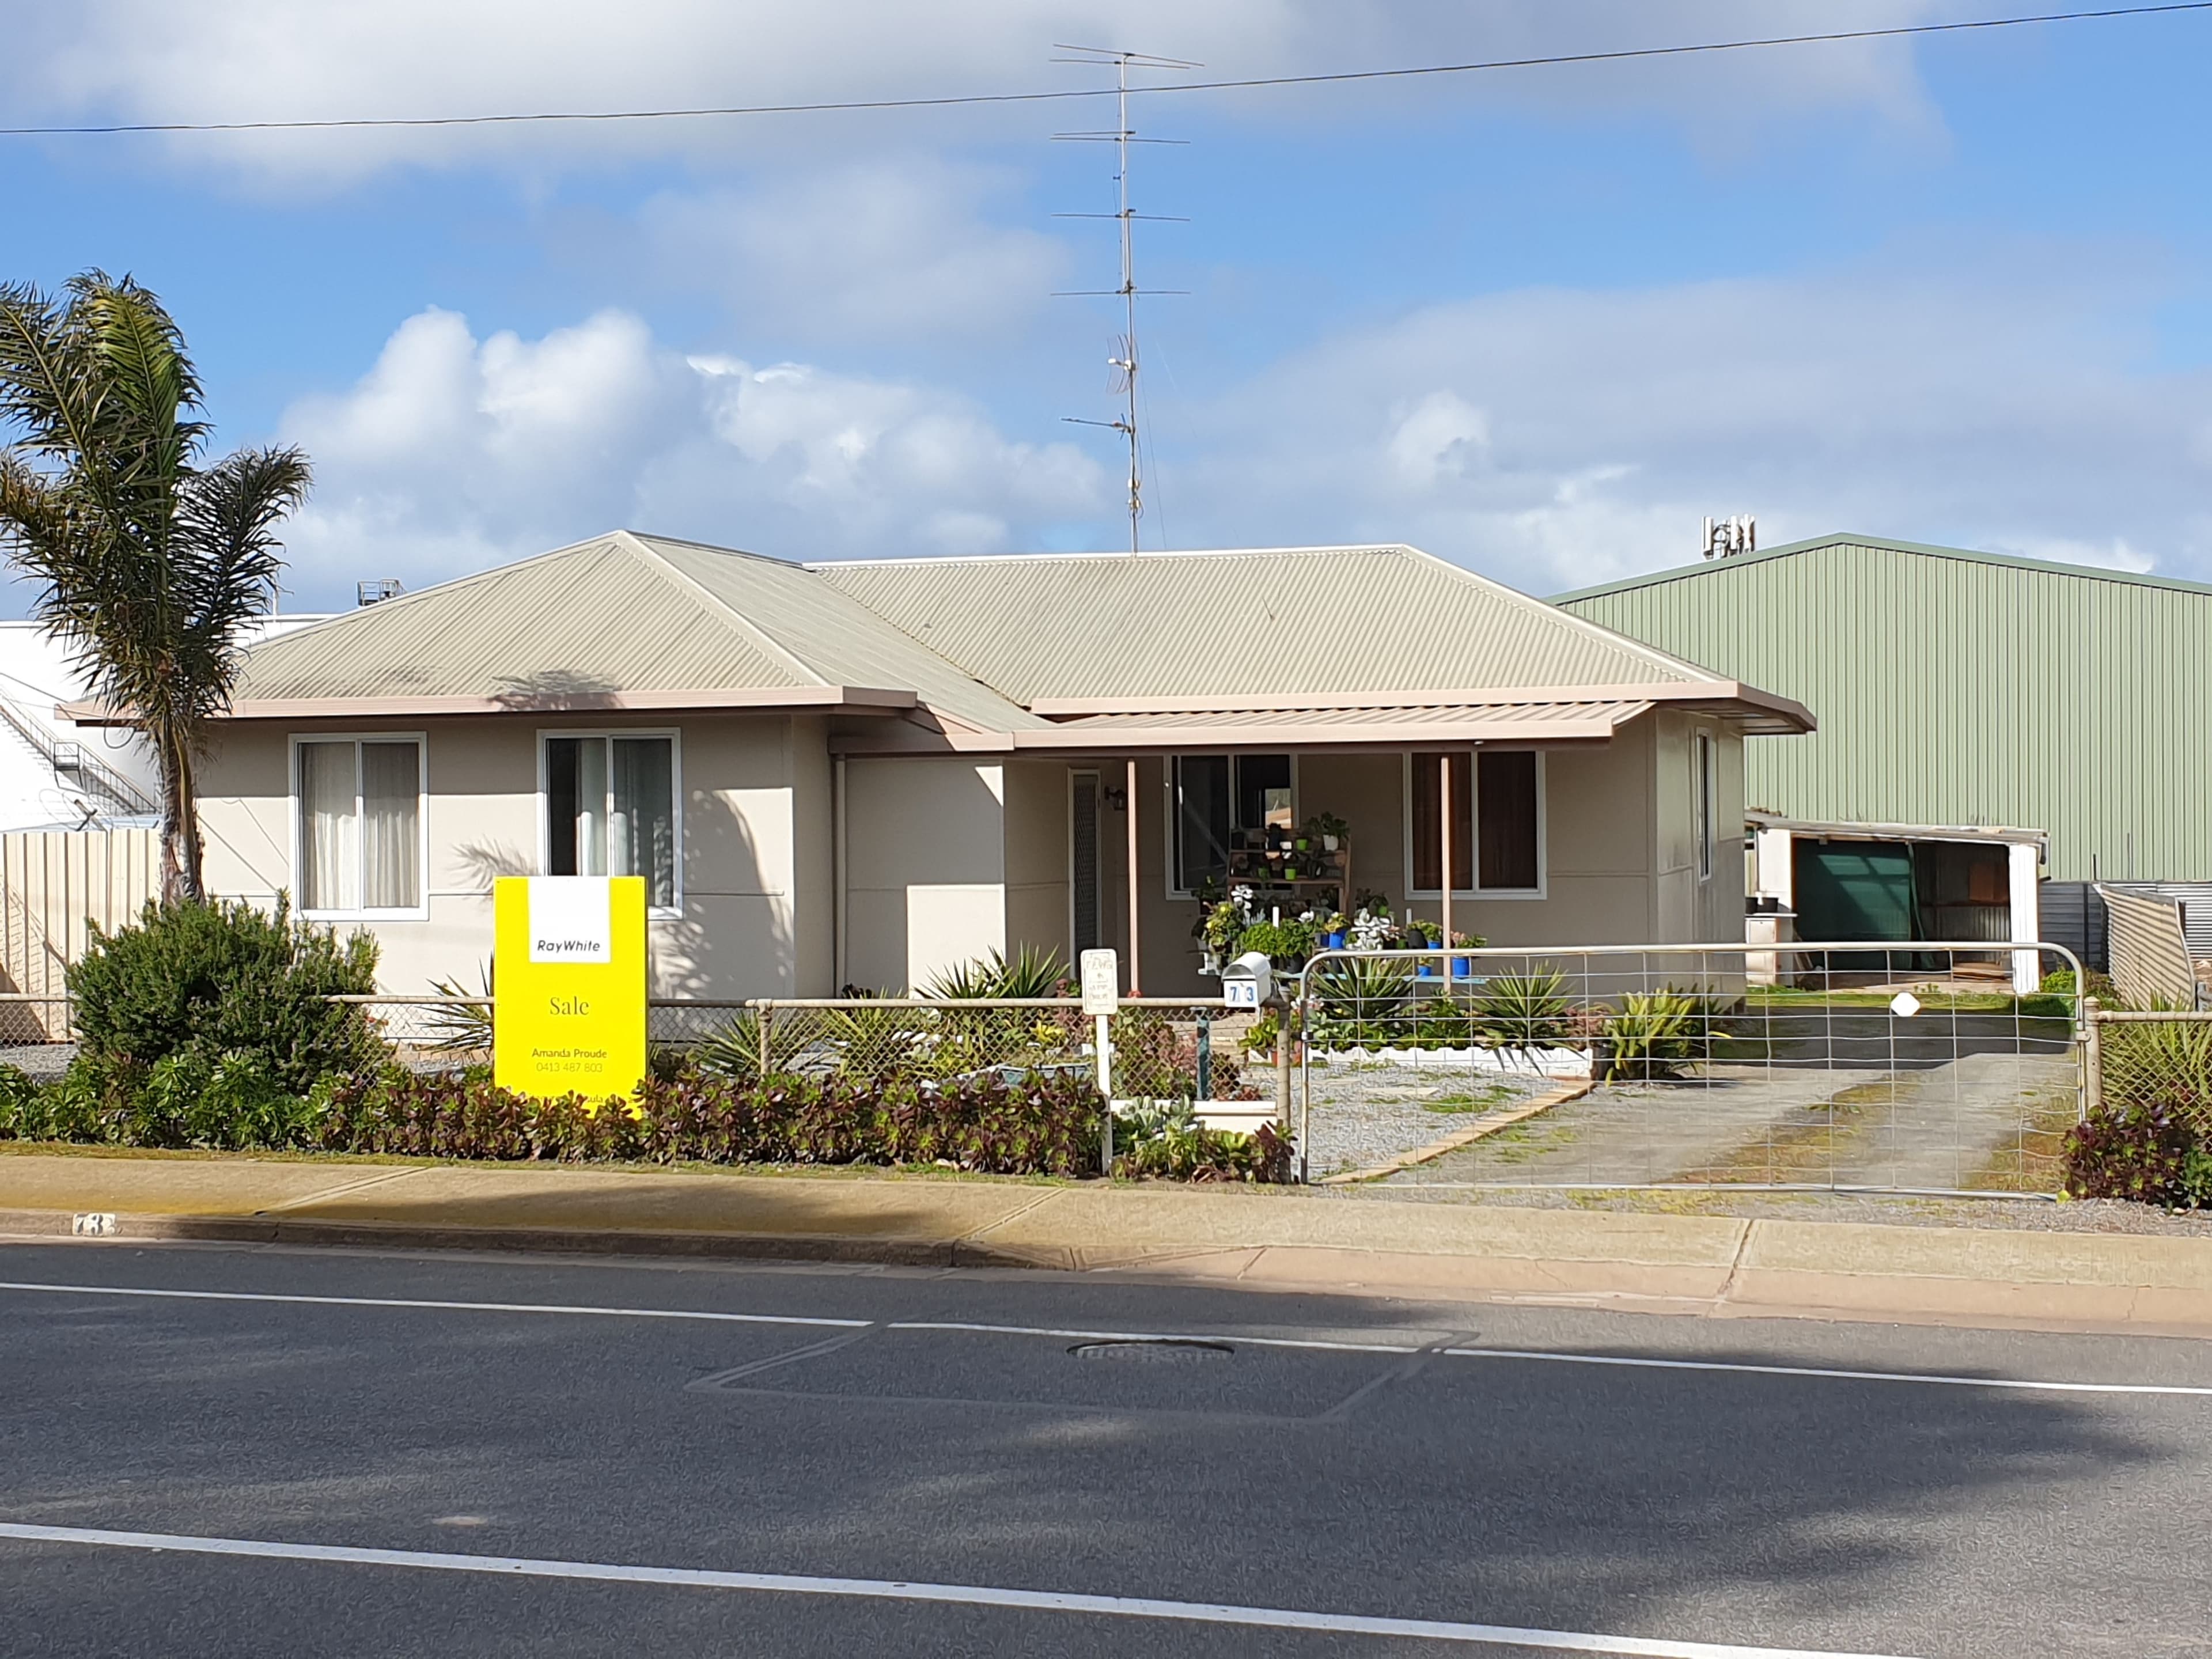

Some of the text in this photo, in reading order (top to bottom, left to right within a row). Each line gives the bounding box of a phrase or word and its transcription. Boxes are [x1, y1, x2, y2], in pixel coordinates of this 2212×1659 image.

[1230, 986, 1254, 1002] 73
[550, 995, 589, 1016] Sale
[532, 1048, 607, 1058] Amanda Proude
[536, 1062, 603, 1073] 0413 487 803
